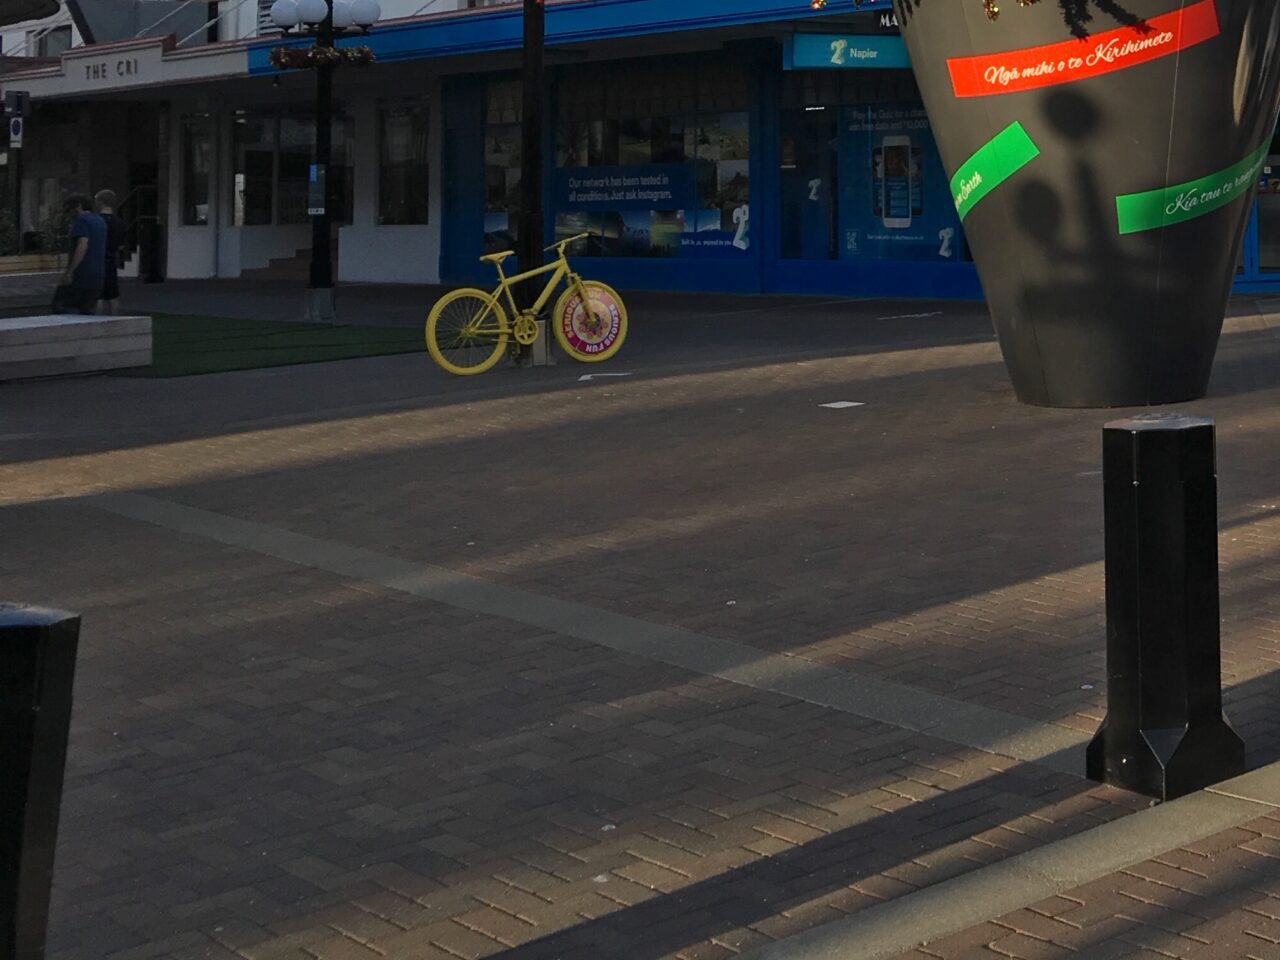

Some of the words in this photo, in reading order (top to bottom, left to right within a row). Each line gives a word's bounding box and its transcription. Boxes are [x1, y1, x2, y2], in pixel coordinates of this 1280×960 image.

[880, 13, 900, 28] MA
[850, 47, 879, 61] Napier
[1022, 61, 1055, 79] mihi
[1057, 60, 1066, 72] o
[1068, 56, 1083, 70] te
[1086, 31, 1174, 67] Kirihimete
[85, 62, 107, 80] THE
[117, 58, 139, 77] CRI
[569, 177, 582, 188] Our
[582, 178, 610, 188] network
[610, 176, 622, 186] has
[623, 176, 639, 186] been
[640, 174, 662, 185] tested
[662, 173, 669, 185] in
[960, 171, 983, 200] Earth
[611, 189, 625, 200] Just
[626, 189, 637, 199] ask
[1166, 188, 1199, 215] Kia
[1200, 188, 1222, 204] tau
[1222, 182, 1234, 194] te
[604, 303, 620, 347] SERIOUS
[585, 342, 605, 353] FUN
